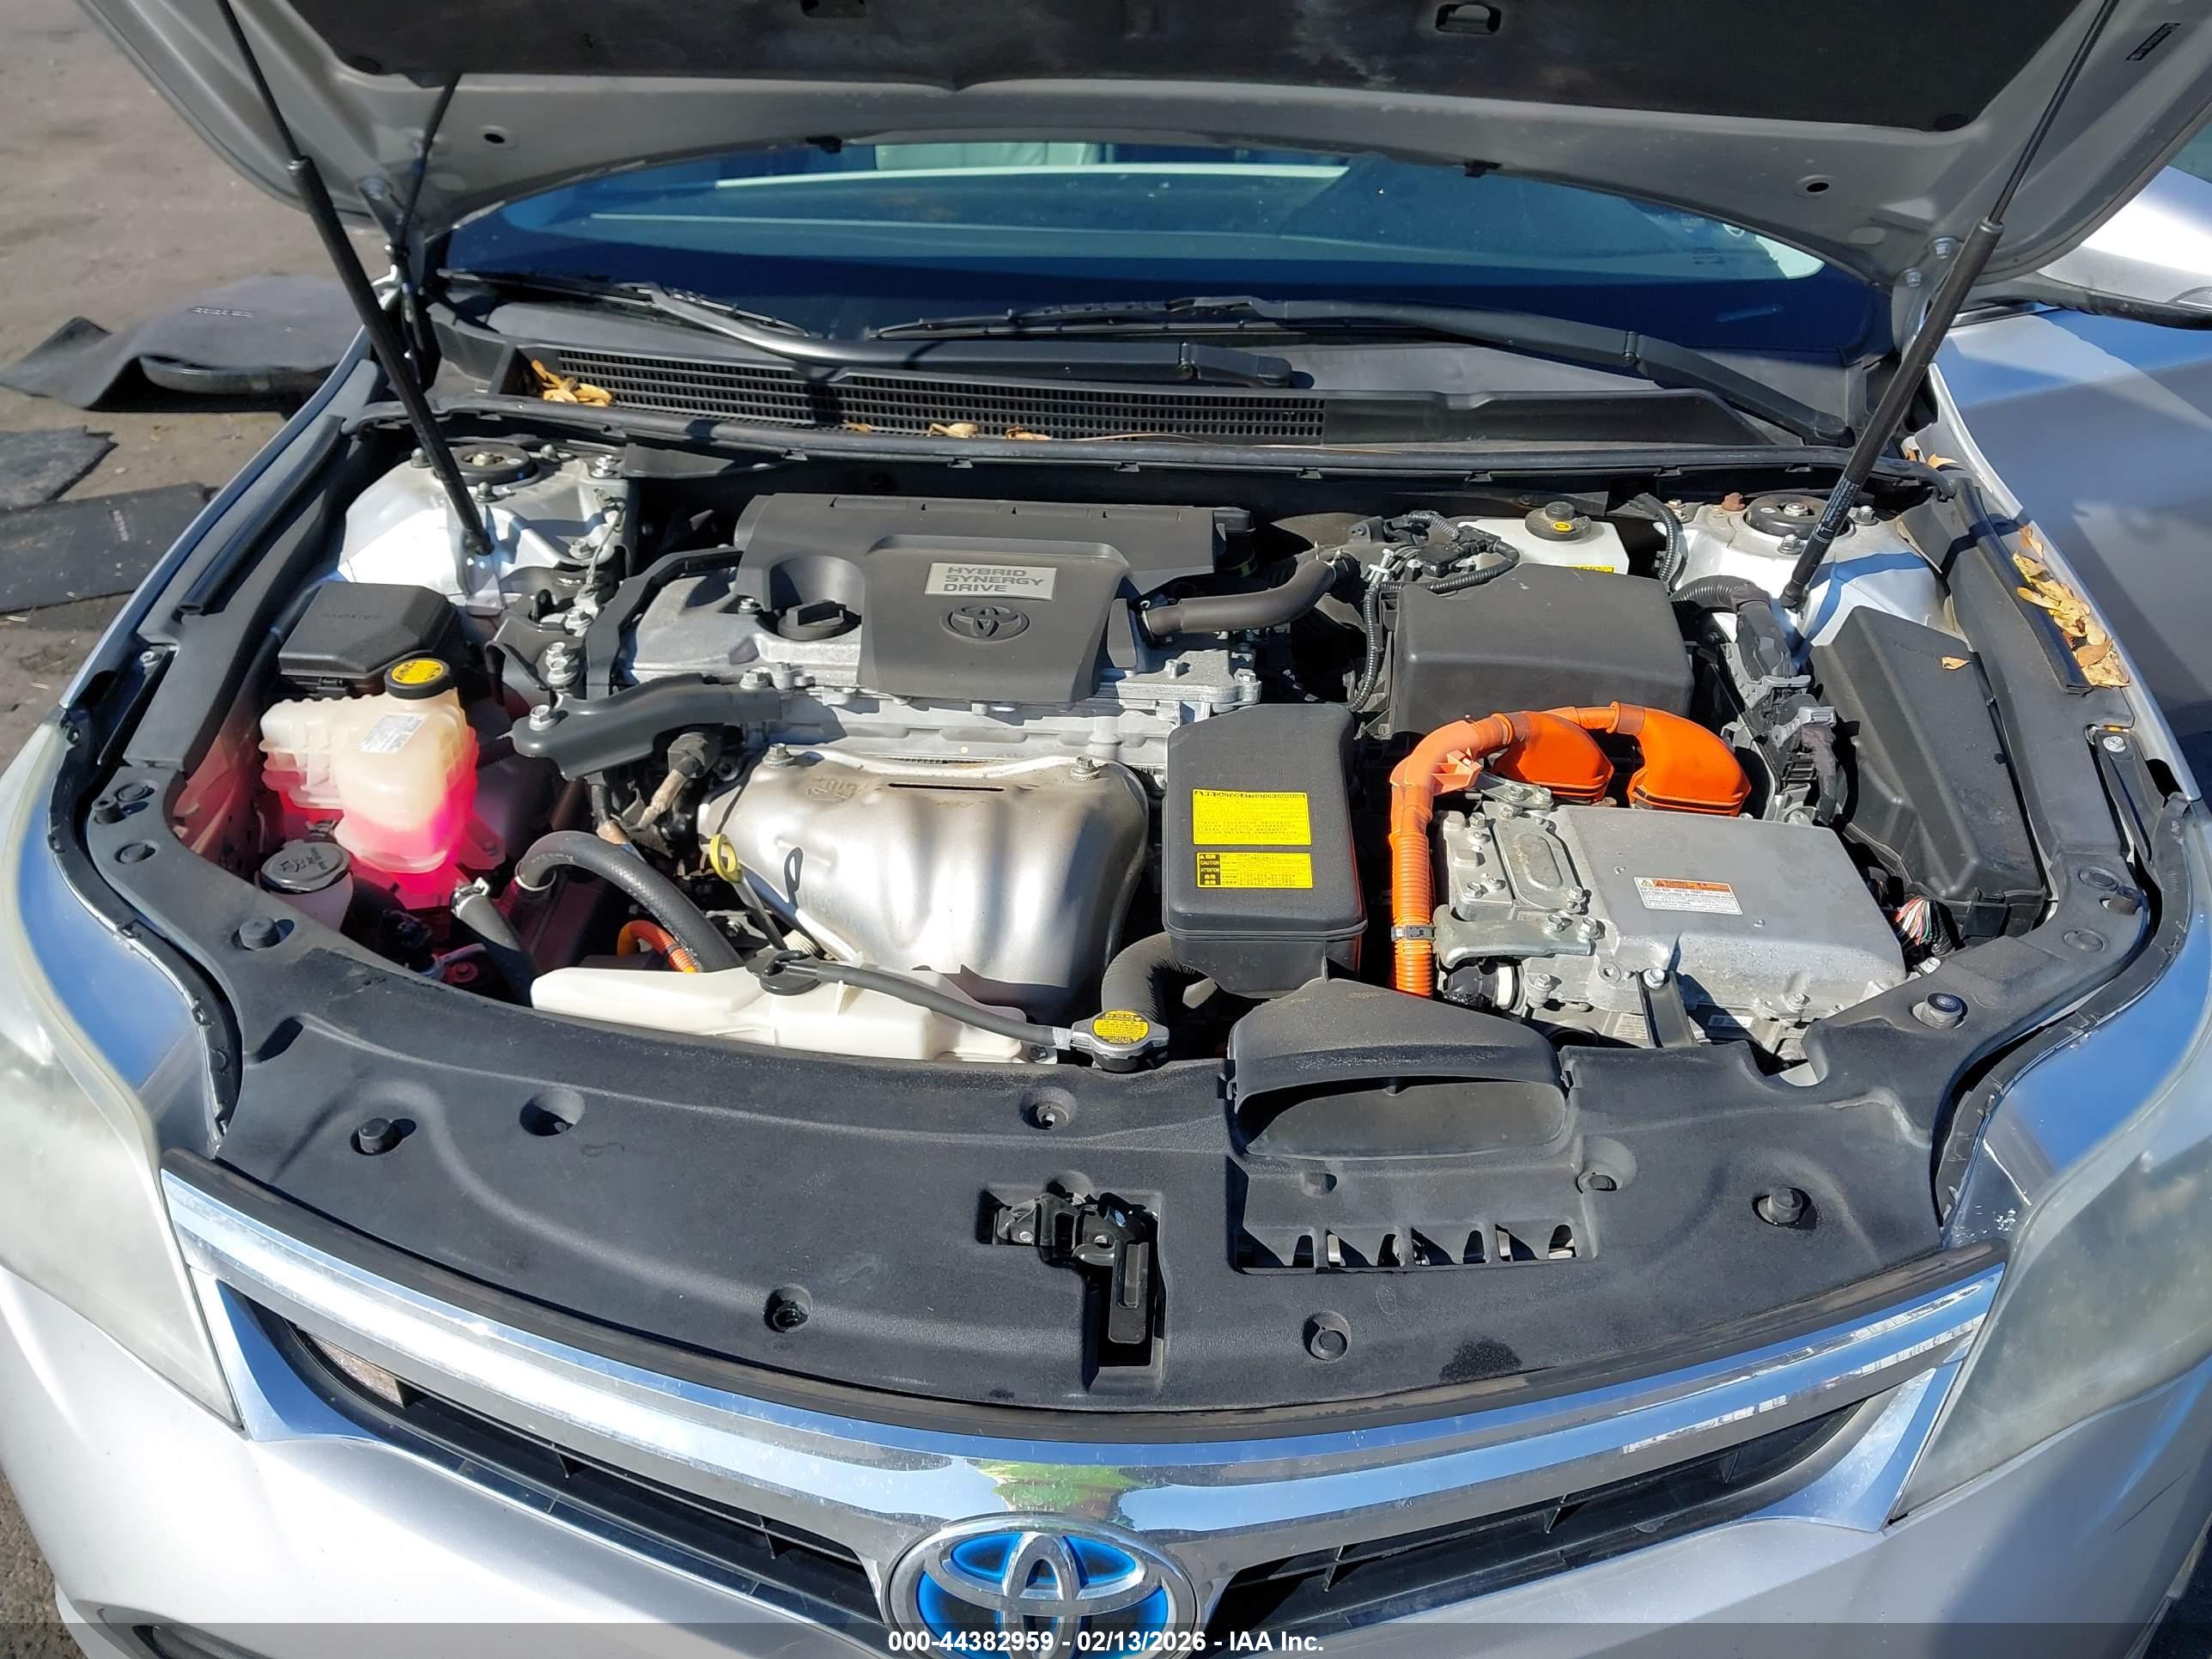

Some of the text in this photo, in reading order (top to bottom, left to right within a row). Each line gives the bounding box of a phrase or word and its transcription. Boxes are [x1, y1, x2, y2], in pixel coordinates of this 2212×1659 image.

[947, 567, 1027, 577] HYBRID
[945, 574, 1045, 586] SYNERGY
[943, 583, 1008, 592] DRIVE
